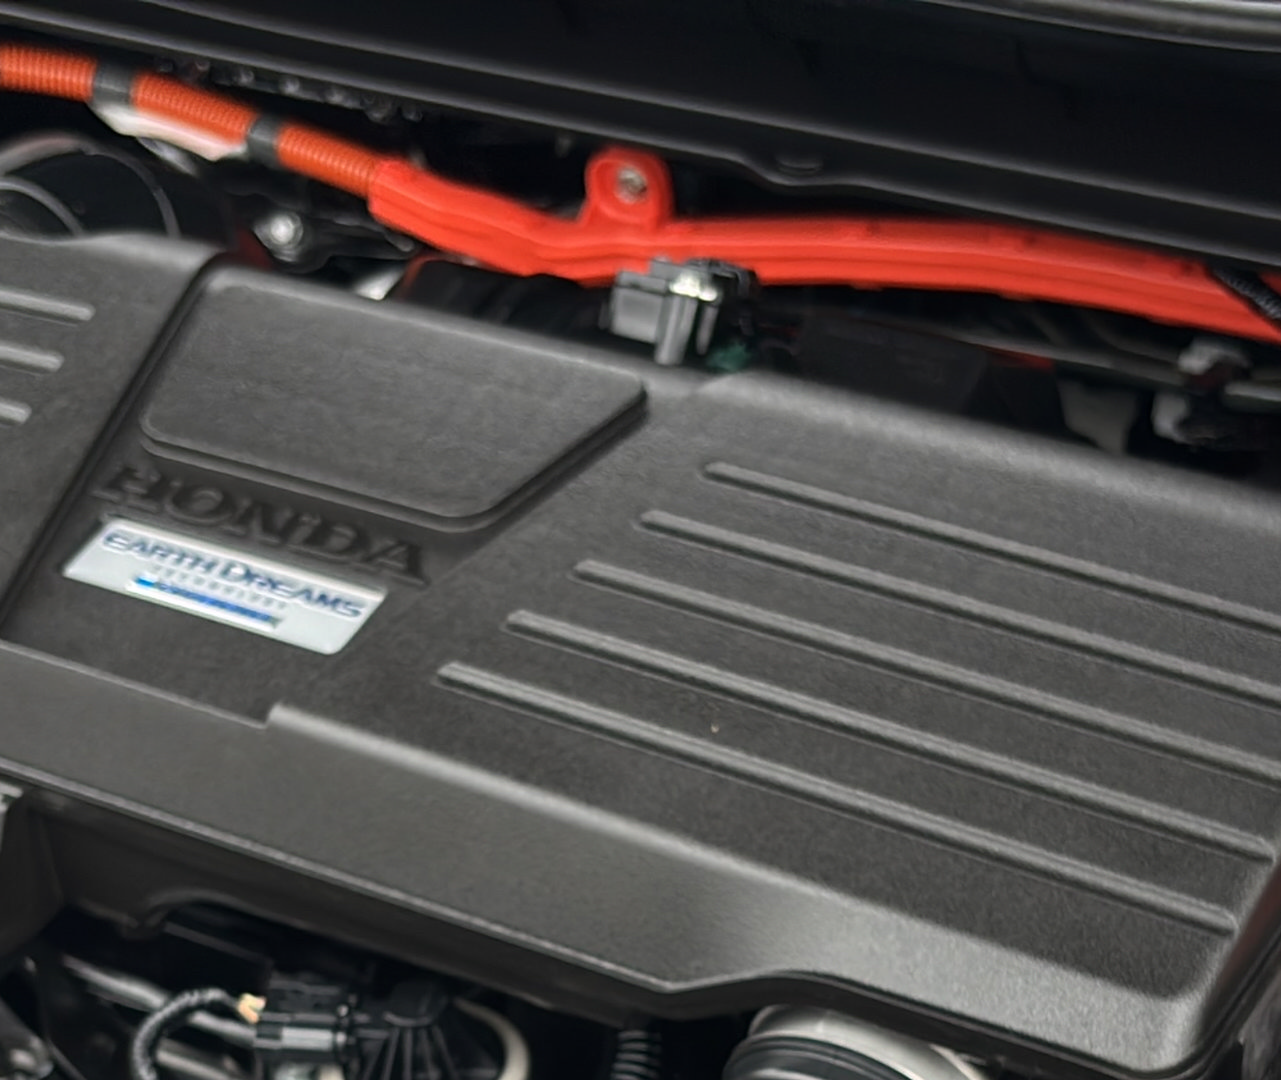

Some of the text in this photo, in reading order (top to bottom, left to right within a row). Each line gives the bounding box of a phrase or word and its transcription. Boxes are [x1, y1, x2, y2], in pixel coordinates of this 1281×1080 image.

[91, 464, 431, 587] HONDA
[103, 532, 363, 620] EARTH DREAMS
